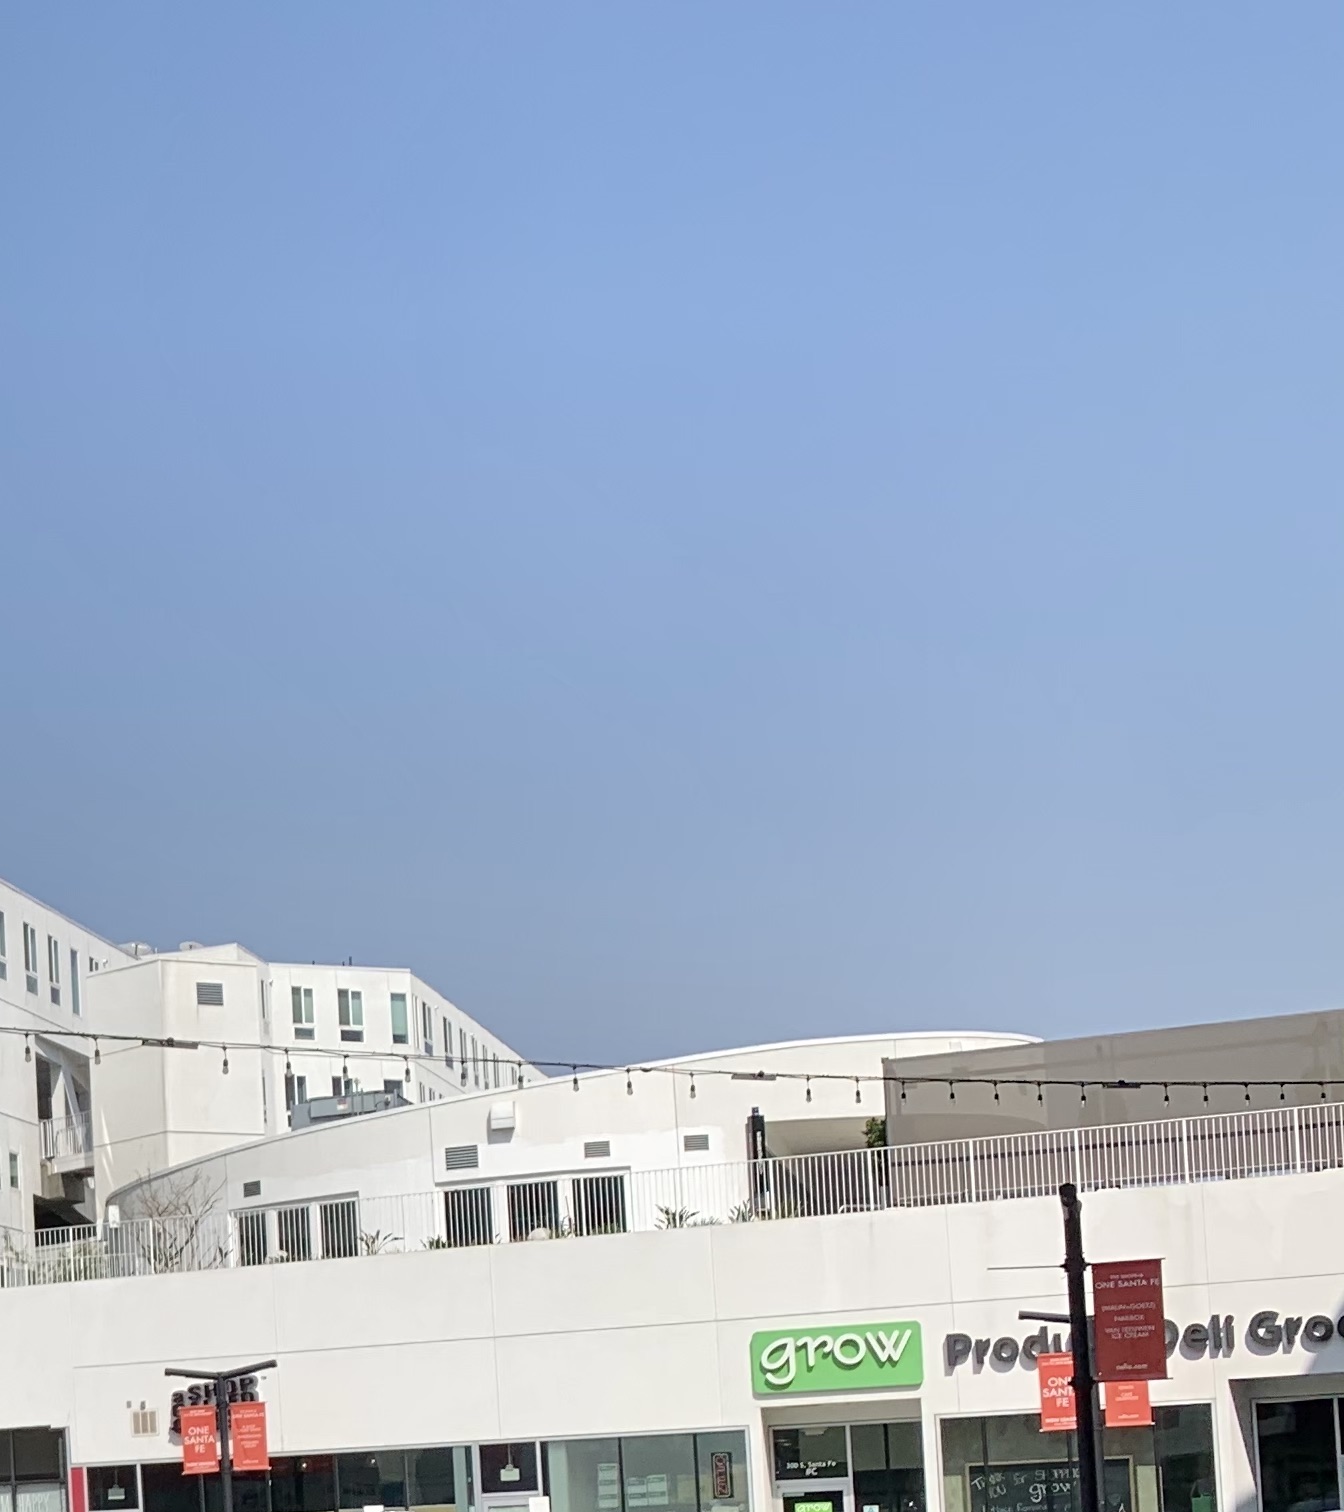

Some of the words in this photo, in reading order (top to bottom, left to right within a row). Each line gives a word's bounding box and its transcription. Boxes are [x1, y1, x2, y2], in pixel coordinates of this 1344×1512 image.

[1095, 1280, 1115, 1290] ONE
[1118, 1278, 1147, 1288] SANTA
[1150, 1277, 1160, 1286] FE
[1248, 1310, 1344, 1347] Gro
[761, 1328, 913, 1385] grow
[1056, 1397, 1069, 1408] FE
[188, 1426, 209, 1436] ONE
[184, 1435, 215, 1445] SANTA
[194, 1444, 206, 1454] FE
